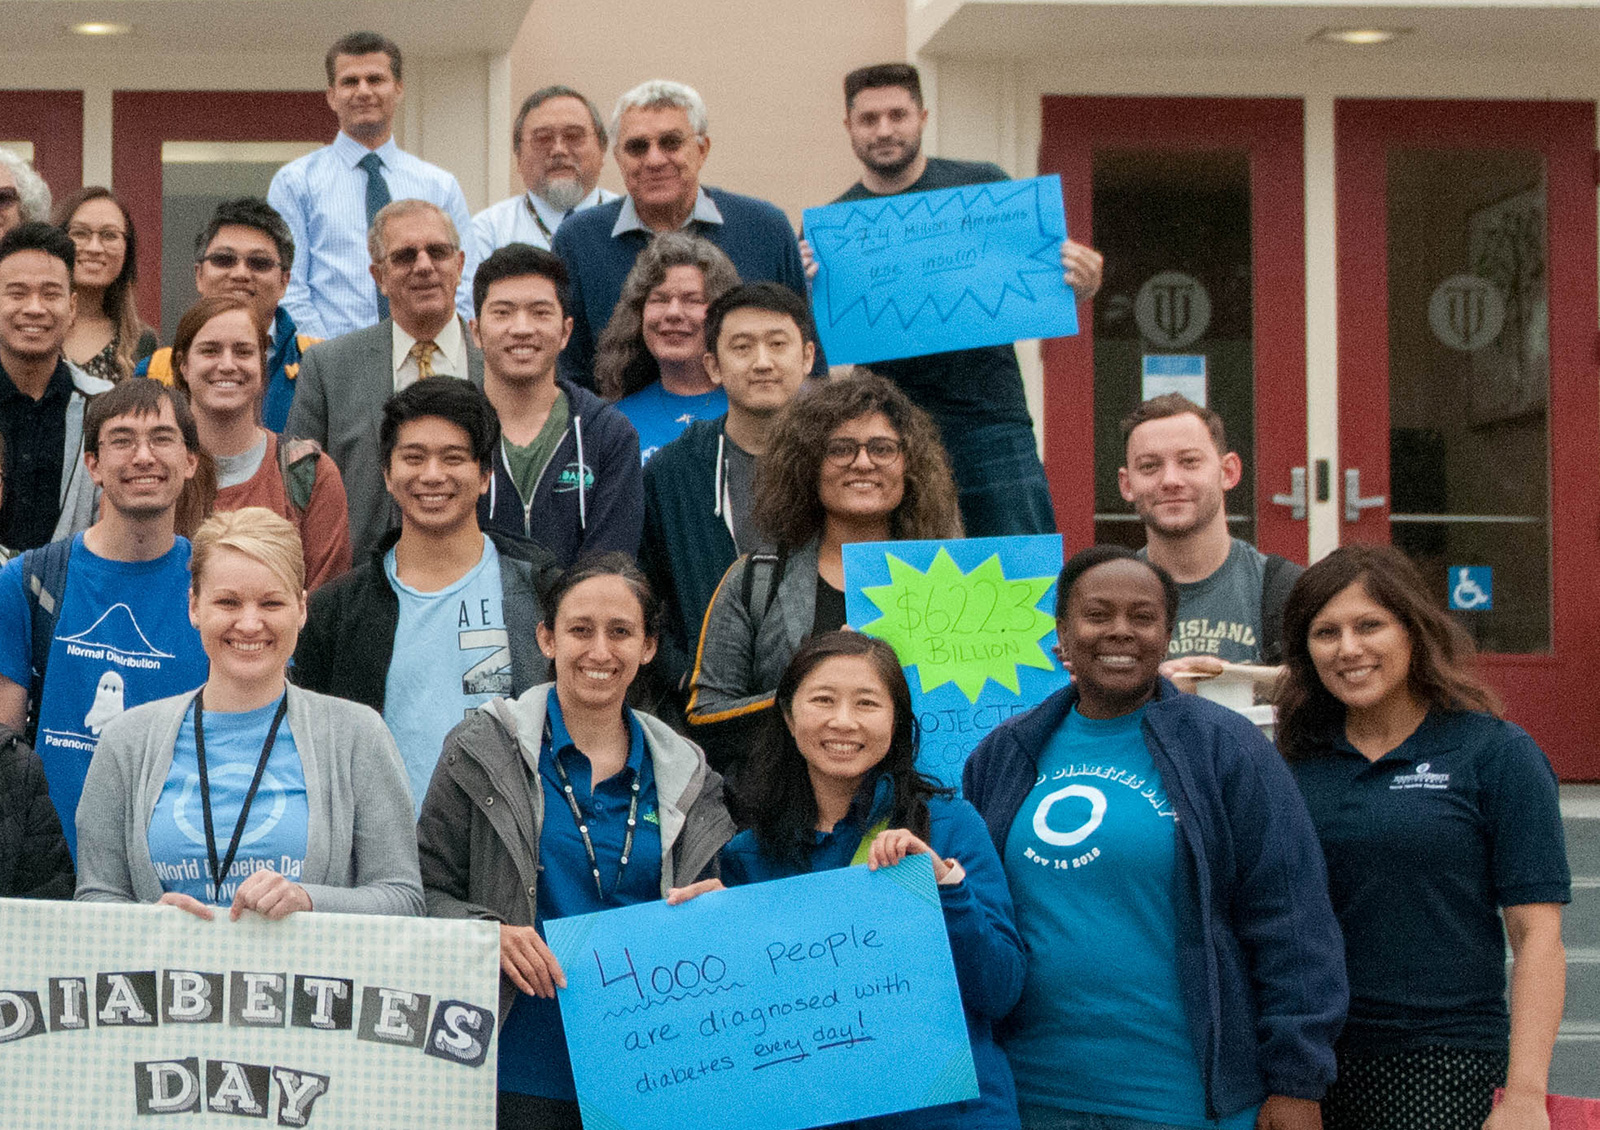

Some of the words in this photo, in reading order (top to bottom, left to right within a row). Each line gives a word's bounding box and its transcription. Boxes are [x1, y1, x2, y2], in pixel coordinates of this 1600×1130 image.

[869, 264, 903, 279] use
[896, 578, 1037, 639] $622.3
[67, 644, 104, 660] Normal
[923, 636, 1020, 665] BILLION
[1168, 638, 1220, 653] ODGE
[153, 858, 200, 880] World
[1024, 846, 1050, 867] Nov
[1054, 858, 1068, 870] 14
[1072, 846, 1101, 868] 2018
[593, 948, 727, 999] 4000
[624, 1023, 680, 1051] are
[699, 989, 841, 1037] diagnosed
[854, 973, 911, 1000] with
[636, 1055, 735, 1094] diabetes
[754, 1037, 806, 1063] every
[812, 1010, 866, 1048] day!
[140, 1059, 326, 1125] DAY
